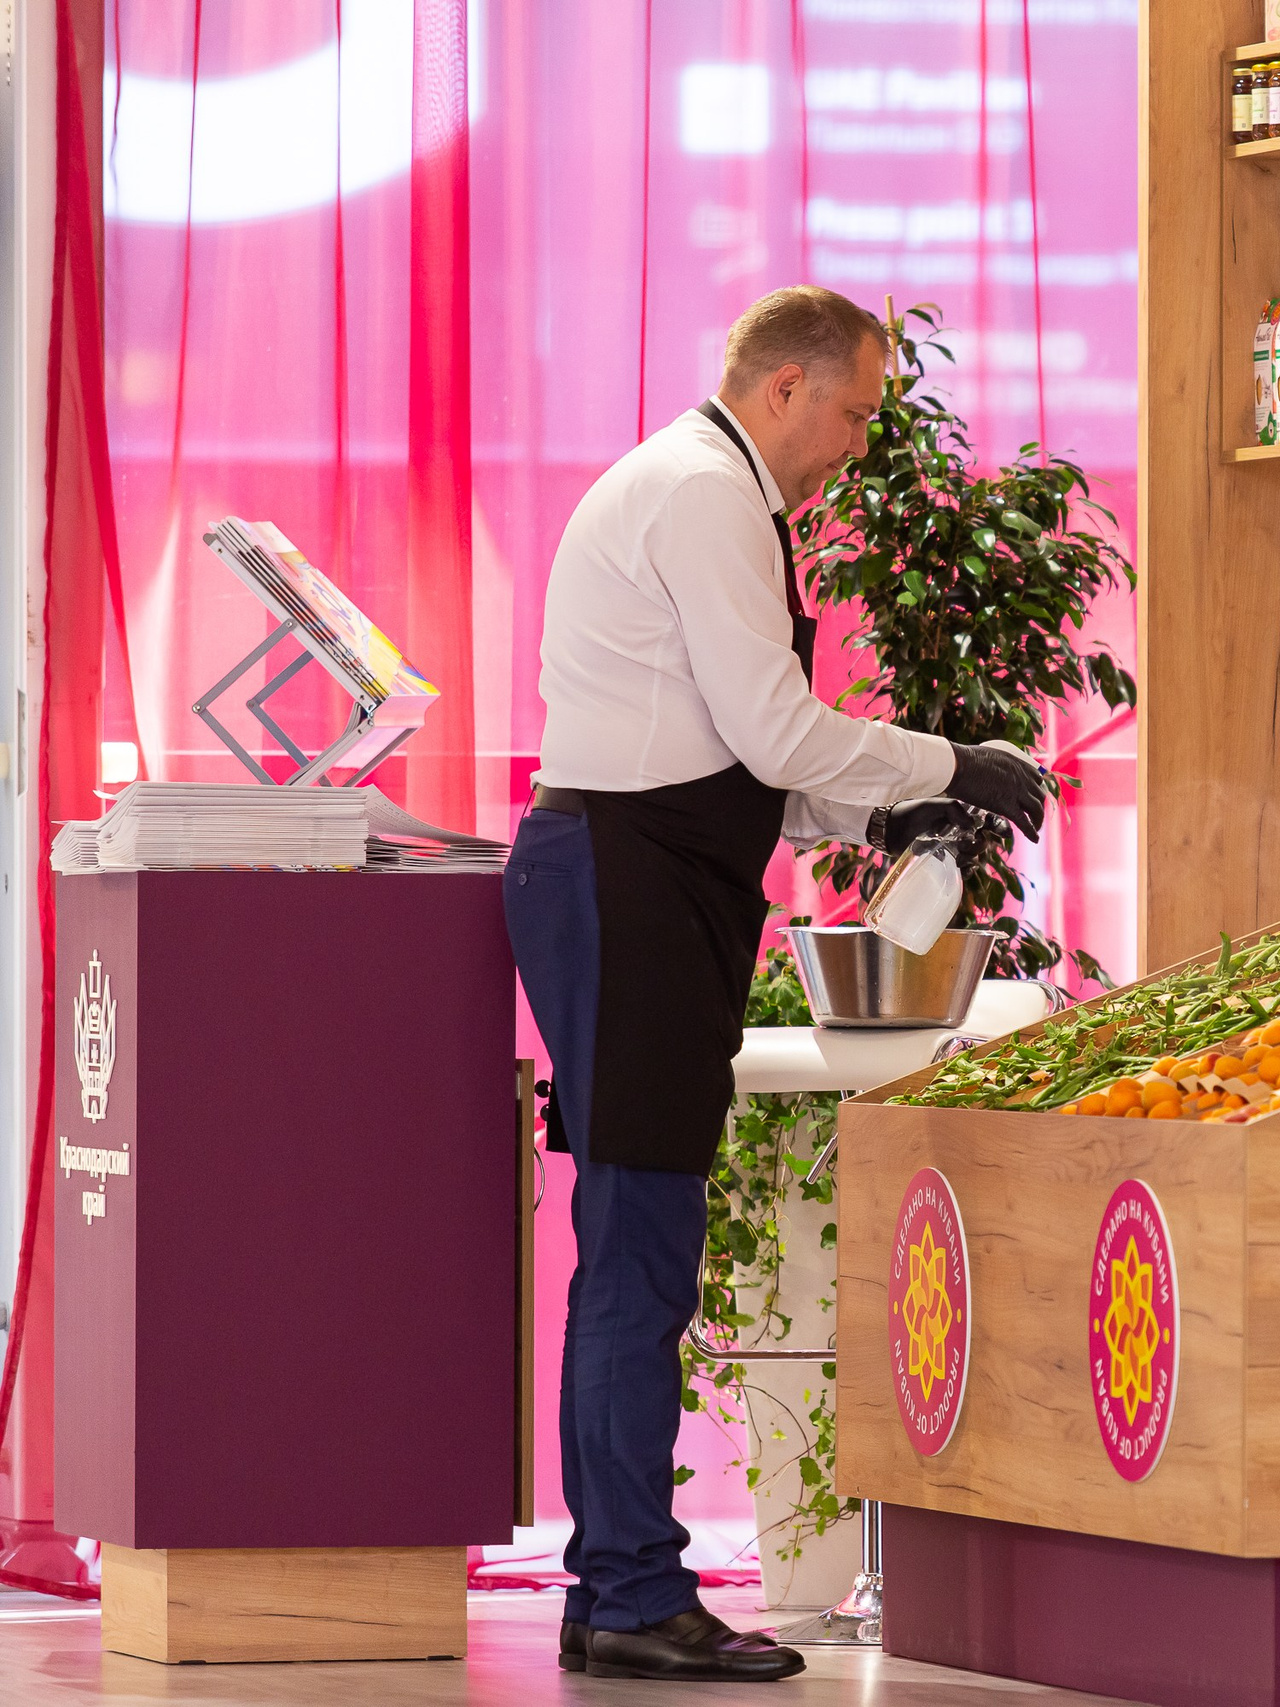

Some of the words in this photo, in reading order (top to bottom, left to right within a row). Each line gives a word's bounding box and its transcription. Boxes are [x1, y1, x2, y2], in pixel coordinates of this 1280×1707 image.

[60, 1136, 130, 1183] Краснодарский
[82, 1184, 106, 1226] край
[895, 1188, 924, 1280] СДЕЛАНО
[925, 1186, 937, 1207] НА
[938, 1197, 961, 1286] КУБАНИ
[1095, 1201, 1128, 1296] СДЕЛАНО
[1128, 1199, 1142, 1220] НА
[1143, 1210, 1170, 1304] КУБАНИ
[895, 1339, 916, 1423] KUBAN
[916, 1412, 928, 1435] OF
[930, 1347, 960, 1435] PRODUCT
[1094, 1359, 1118, 1446] KUBAN
[1133, 1369, 1168, 1462] PRODUCT
[1119, 1436, 1132, 1461] OF
